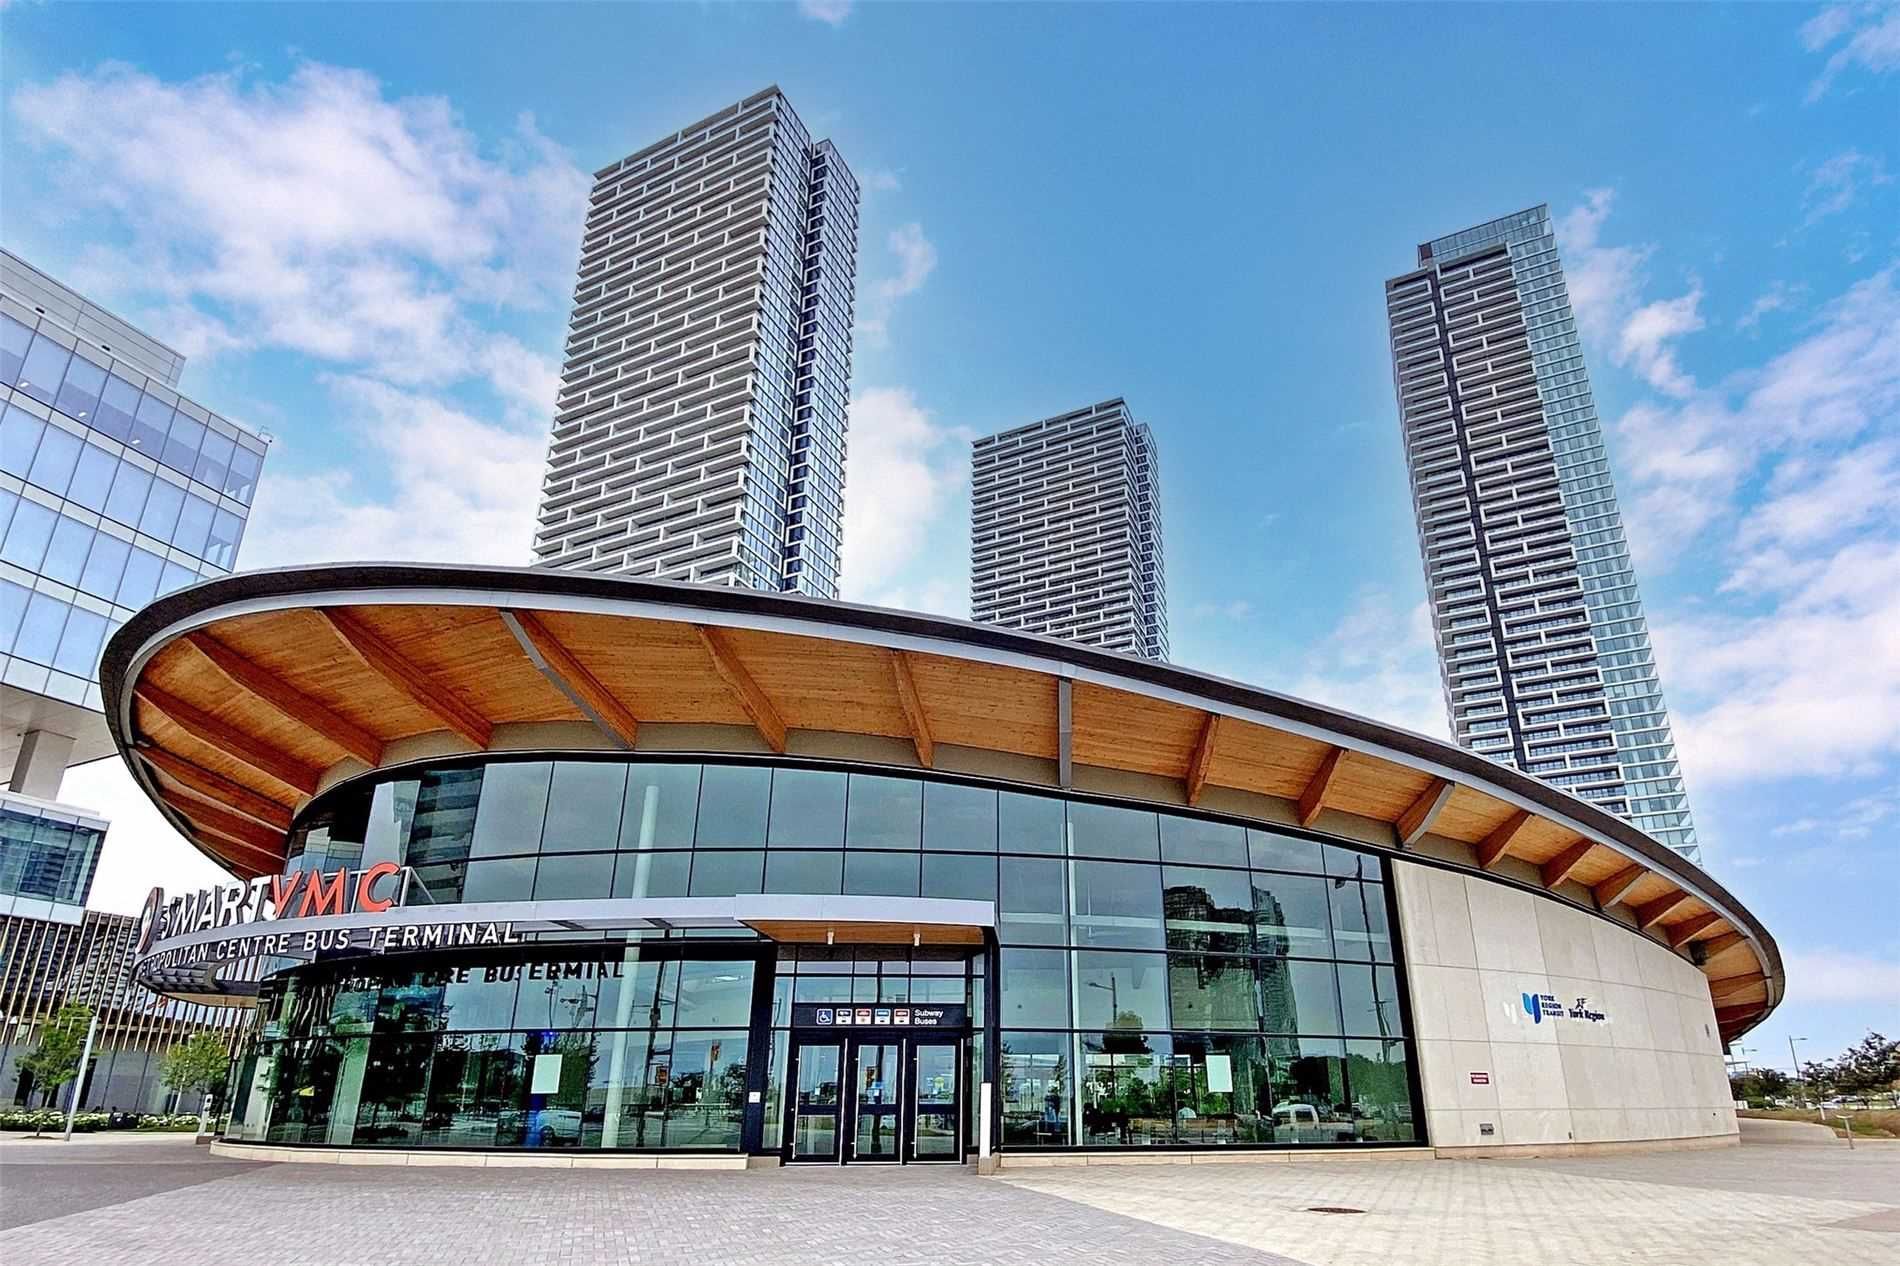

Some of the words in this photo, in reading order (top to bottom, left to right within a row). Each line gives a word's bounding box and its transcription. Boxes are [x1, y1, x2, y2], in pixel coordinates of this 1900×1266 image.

[216, 933, 291, 960] CENTRE
[303, 929, 350, 951] BUS
[368, 922, 519, 948] TERMINAL
[914, 1008, 944, 1018] Subway
[914, 1017, 937, 1025] Buses
